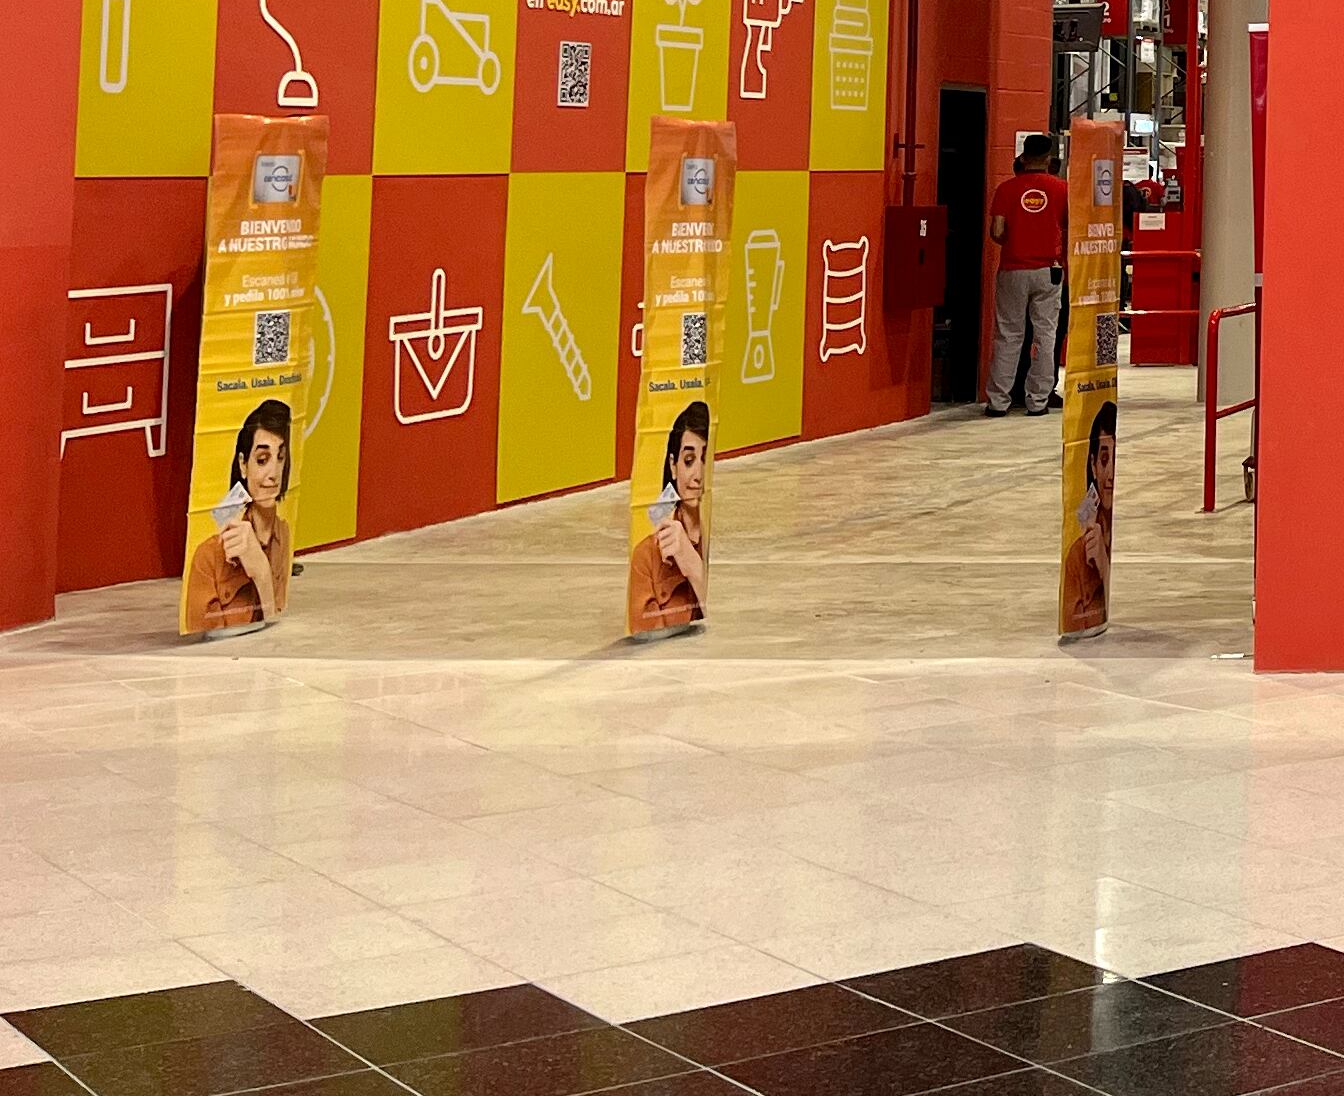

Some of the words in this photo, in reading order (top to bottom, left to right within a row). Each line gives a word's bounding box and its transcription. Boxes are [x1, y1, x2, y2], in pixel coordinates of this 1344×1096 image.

[218, 239, 227, 253] A
[652, 240, 660, 254] A
[661, 239, 704, 254] NUESTR
